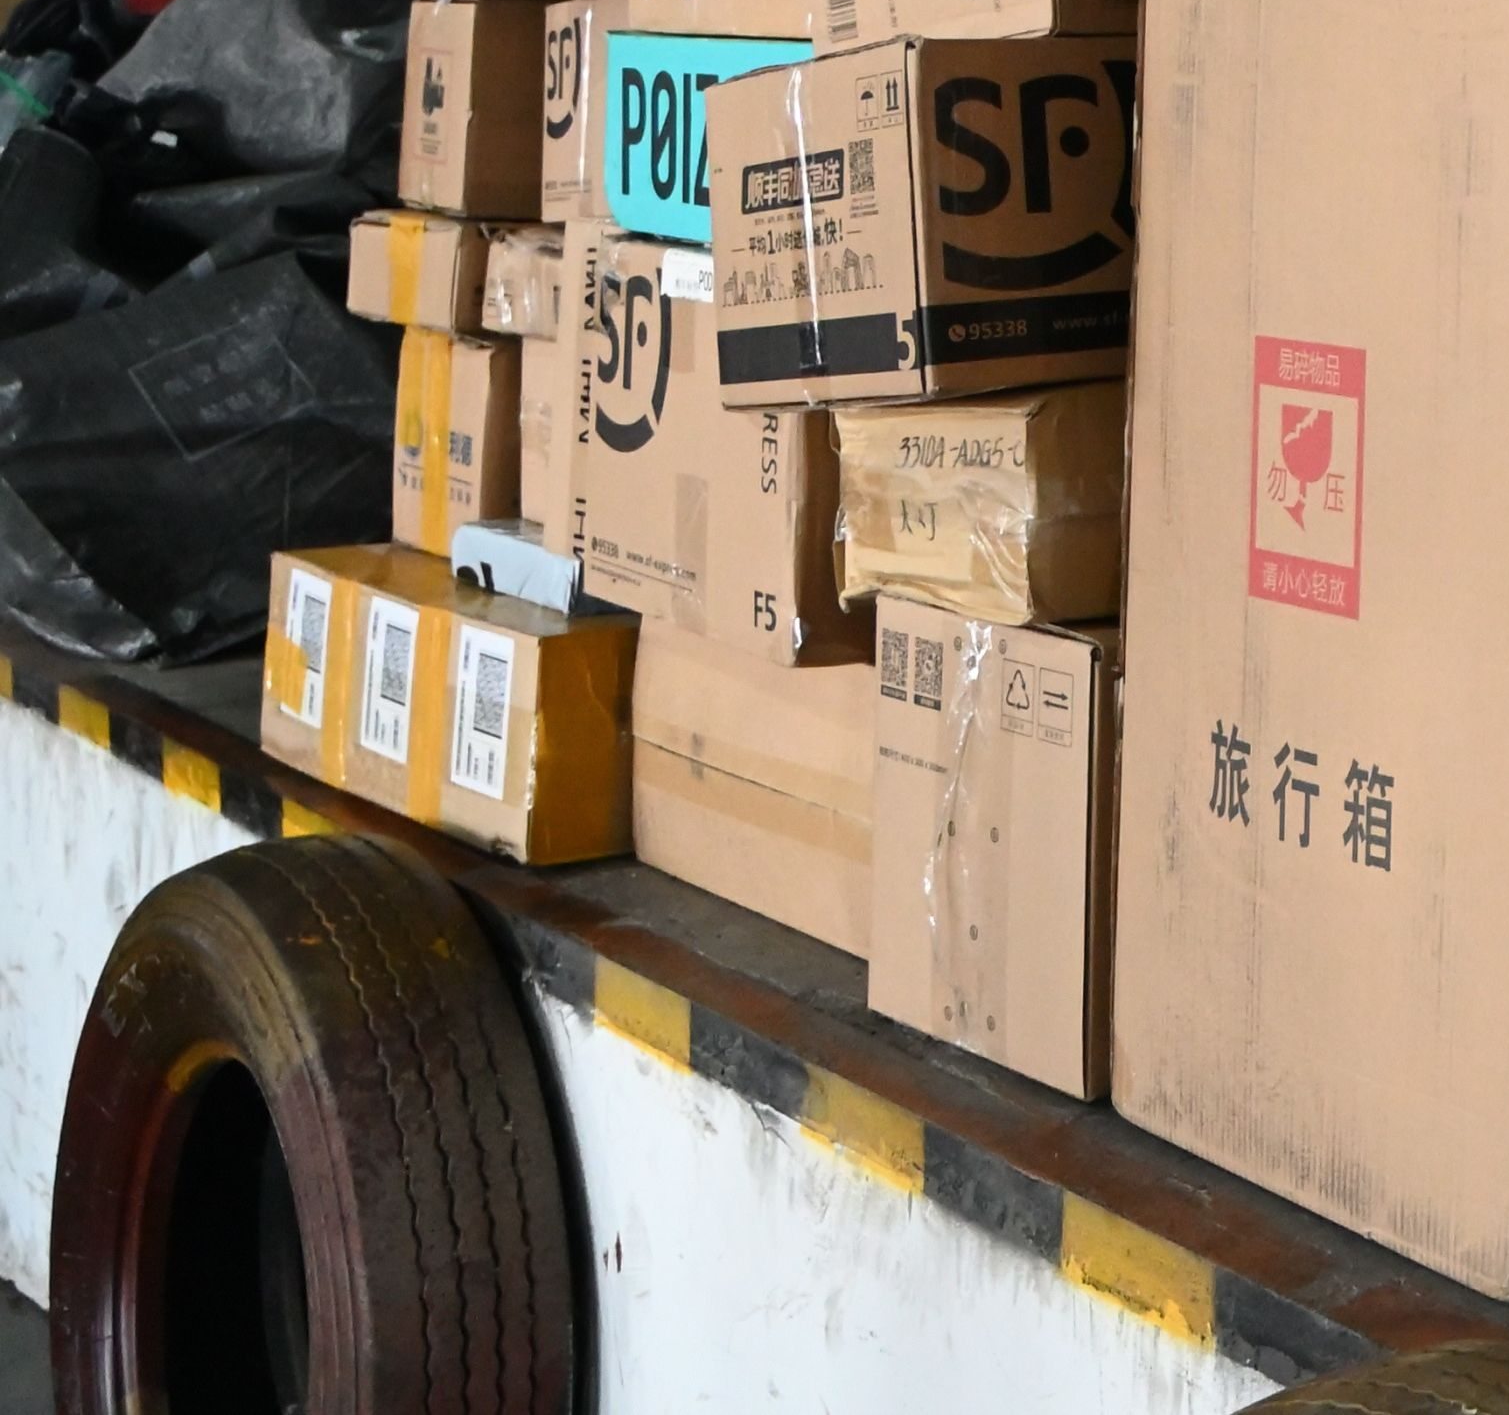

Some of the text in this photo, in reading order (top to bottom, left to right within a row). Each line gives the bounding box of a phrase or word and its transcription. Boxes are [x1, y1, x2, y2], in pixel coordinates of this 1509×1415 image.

[934, 75, 1099, 216] SF
[968, 320, 1028, 341] 95338
[1279, 348, 1341, 386] 易碎物品
[761, 413, 779, 494] RESS
[1266, 460, 1346, 513] 勿 压
[1263, 561, 1345, 607] 请小心轻放
[753, 589, 778, 632] F5
[1209, 719, 1396, 873] 旅行箱
